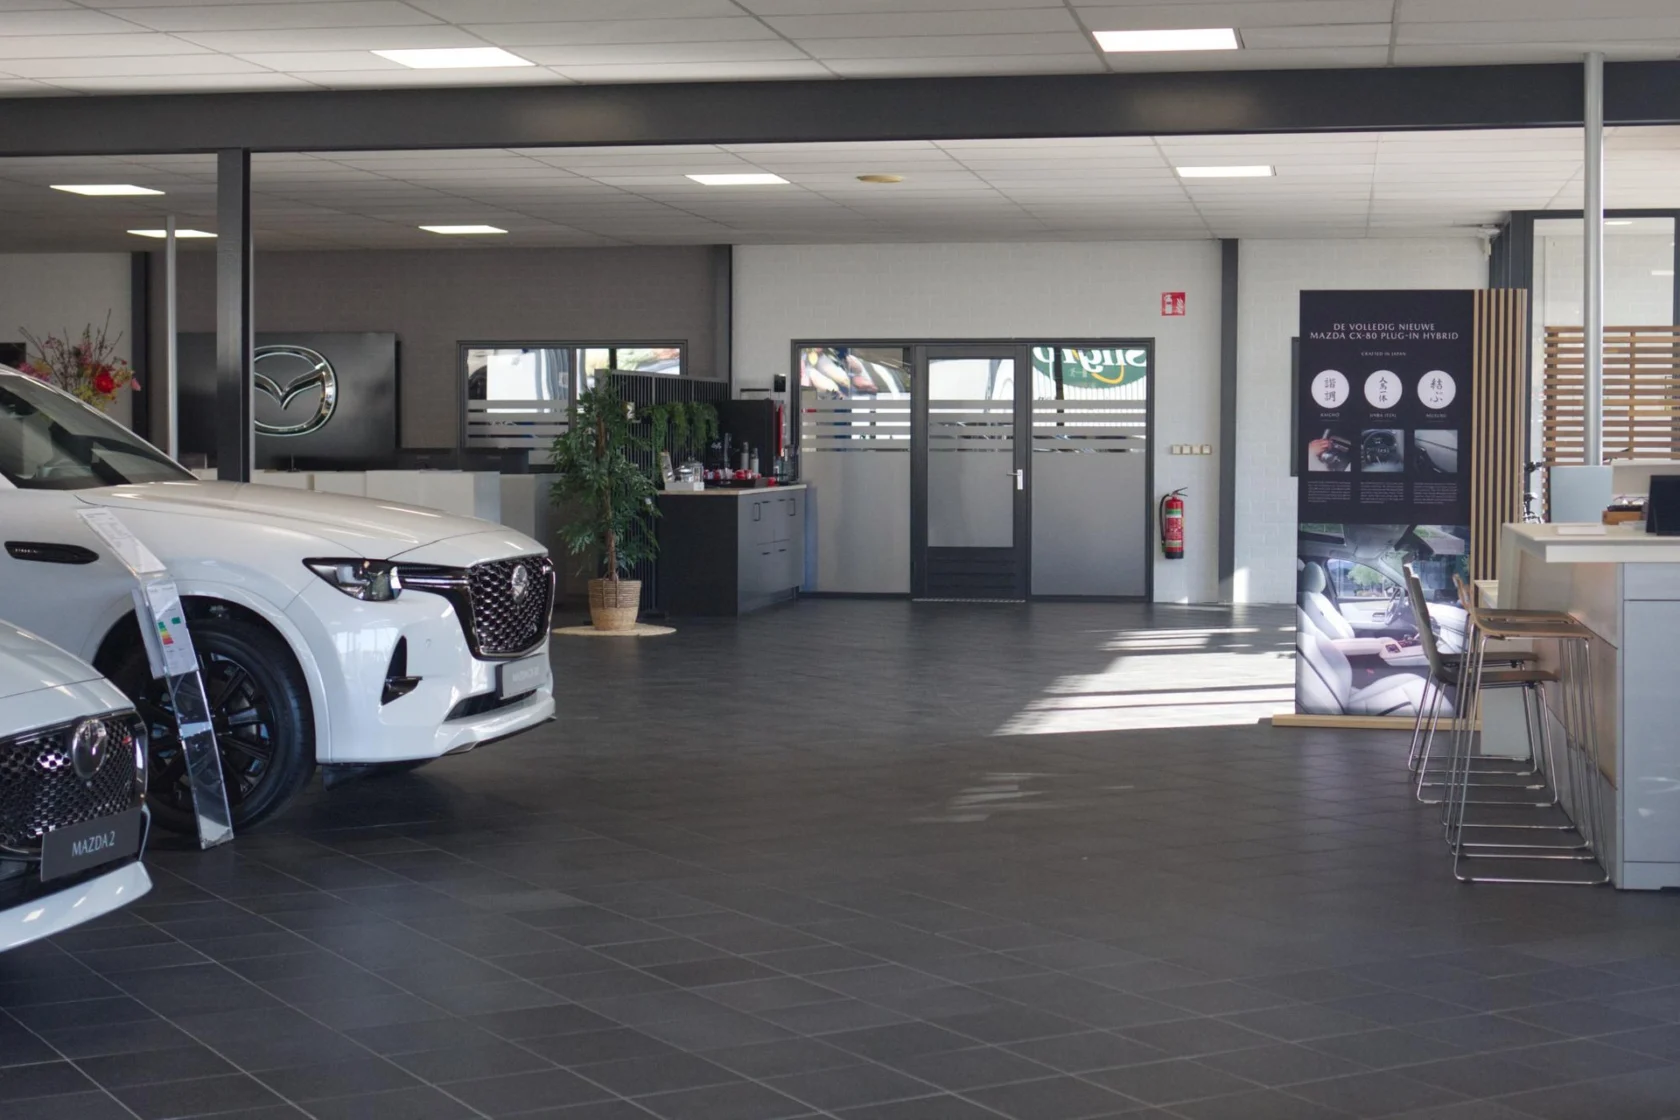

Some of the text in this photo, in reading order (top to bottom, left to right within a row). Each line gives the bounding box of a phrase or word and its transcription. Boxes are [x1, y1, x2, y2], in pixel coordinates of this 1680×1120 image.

[1333, 323, 1436, 331] DE VOLLEDIG NIEUWE
[1309, 331, 1459, 340] MAZDA CX-80 PLUG-IN HYBRID
[71, 830, 115, 857] MAZDA2
